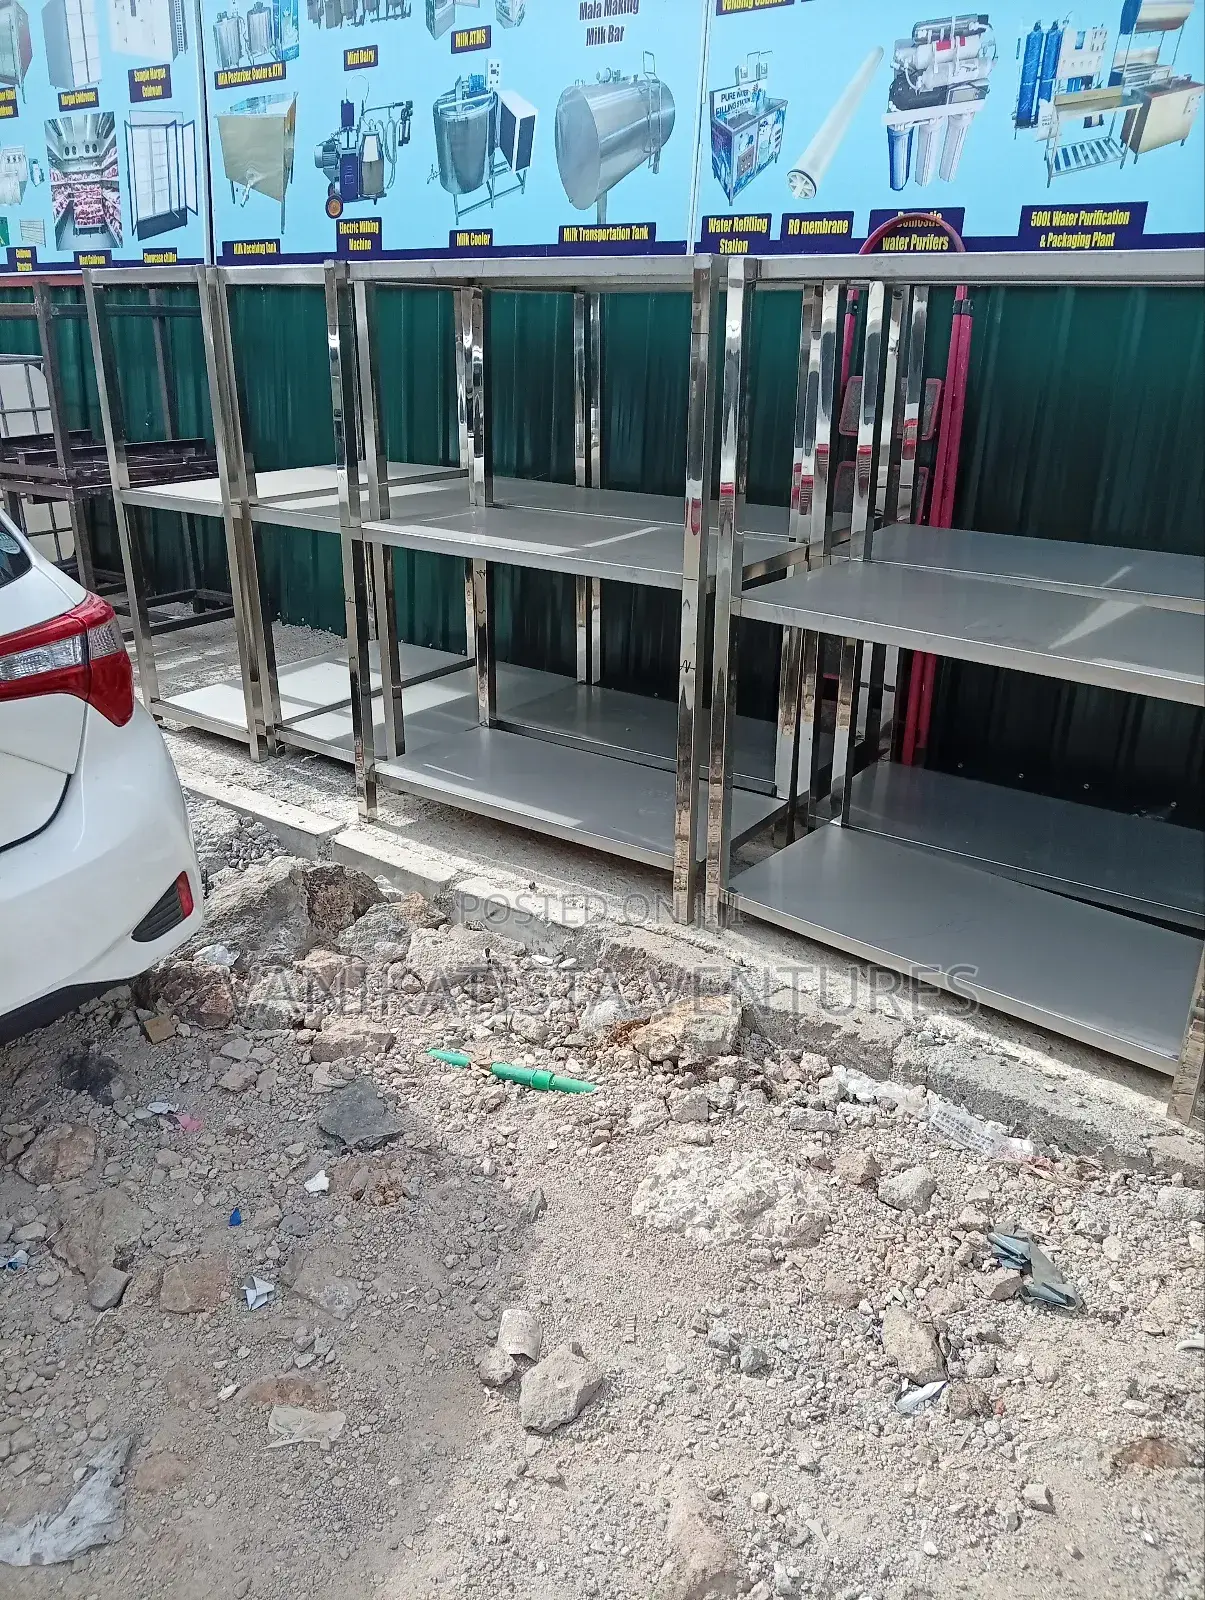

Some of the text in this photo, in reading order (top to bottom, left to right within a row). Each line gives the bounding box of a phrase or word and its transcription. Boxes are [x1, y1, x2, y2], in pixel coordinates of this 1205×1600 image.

[579, 0, 640, 21] Mala Making
[586, 24, 625, 47] Milk Bar
[360, 48, 375, 63] Dairy
[708, 215, 768, 233] Water Refilling
[787, 217, 849, 235] RO membrane
[1051, 210, 1079, 226] Water
[1078, 208, 1131, 226] Purification
[456, 231, 491, 247] Milk Cooler
[562, 224, 649, 242] Milk Transportation Tank
[1039, 231, 1116, 249] & Packaging Plant
[348, 237, 372, 251] Machine
[719, 237, 749, 254] Station
[882, 234, 911, 251] water
